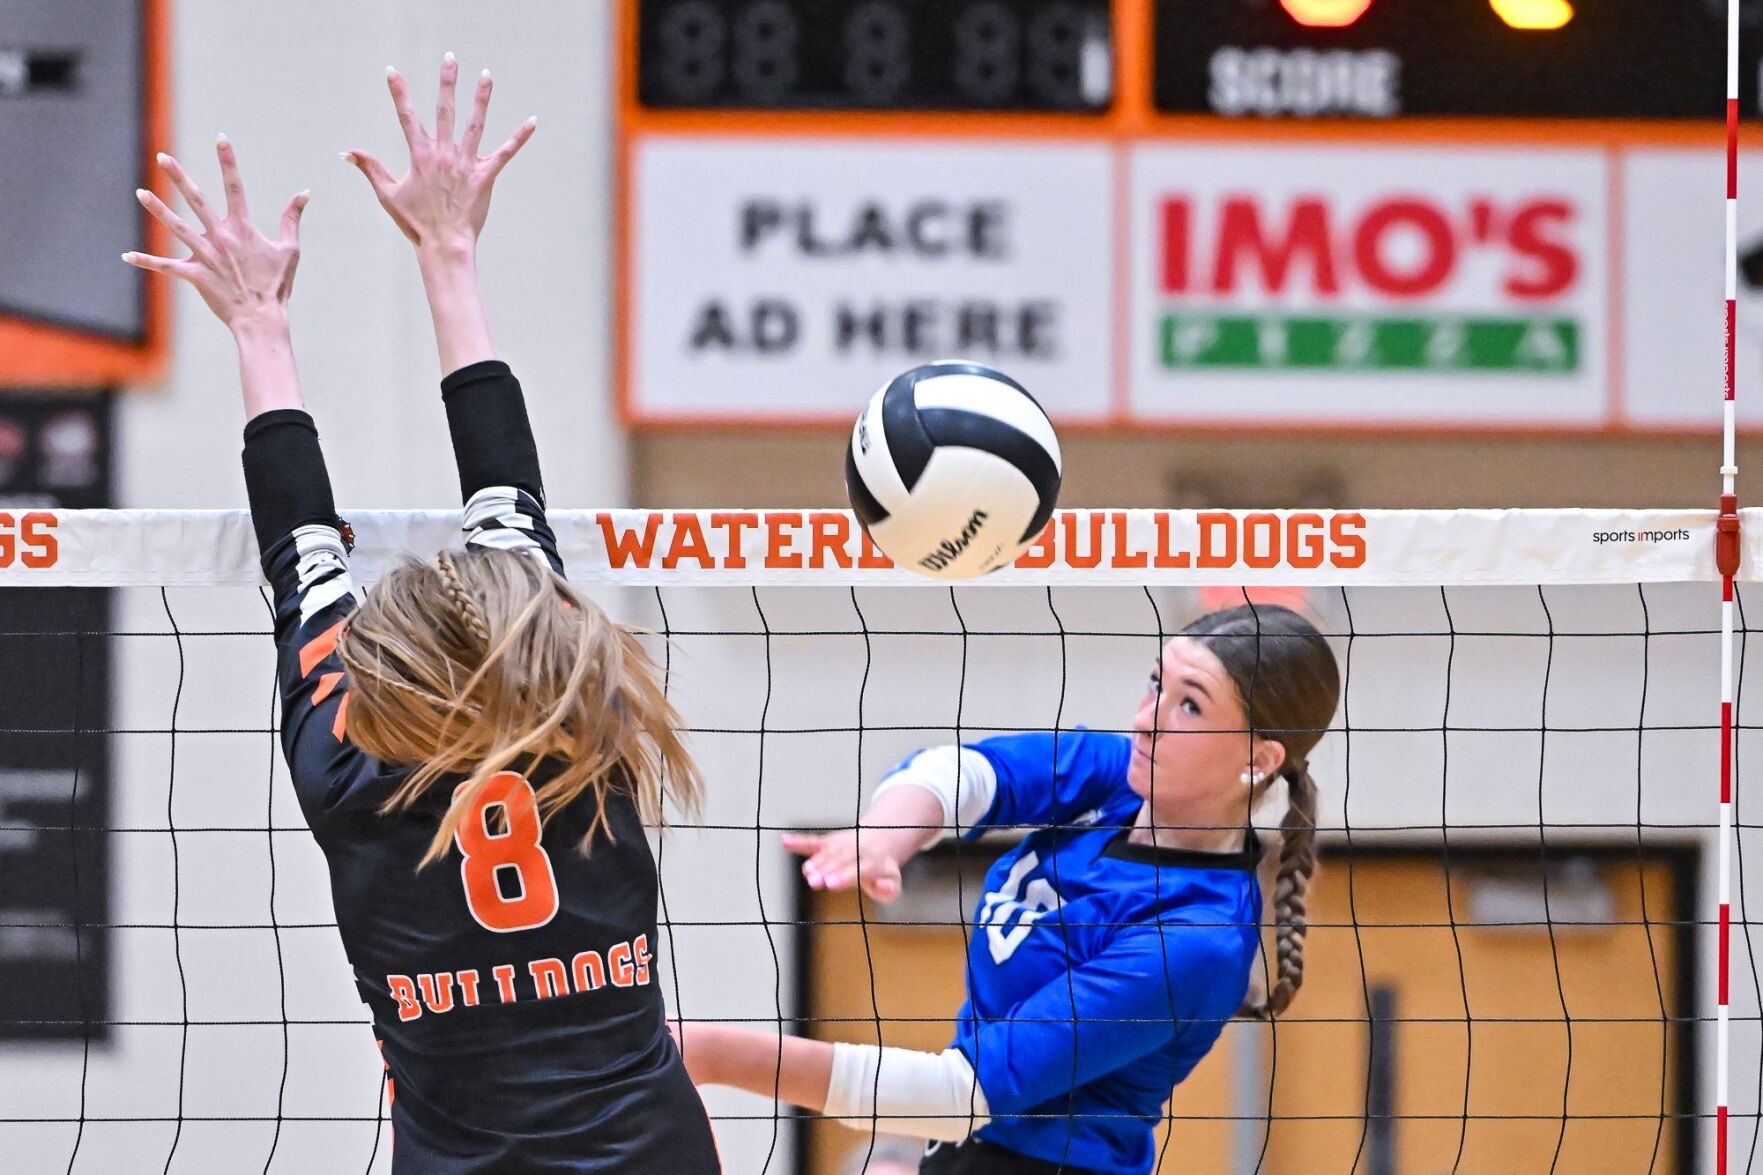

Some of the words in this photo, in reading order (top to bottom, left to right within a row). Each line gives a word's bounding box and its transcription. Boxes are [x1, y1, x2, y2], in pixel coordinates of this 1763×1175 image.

[1209, 49, 1400, 113] SCORE
[738, 199, 1010, 256] PLACE
[1159, 194, 1580, 299] IMO'S
[690, 301, 801, 352] AD
[834, 301, 1060, 354] HERE
[1171, 315, 1567, 369] PIZZA
[918, 507, 989, 571] Wilson
[1014, 512, 1366, 568] BULLDOGS
[1592, 530, 1635, 544] sports
[1637, 529, 1690, 543] imports
[452, 770, 559, 933] 8
